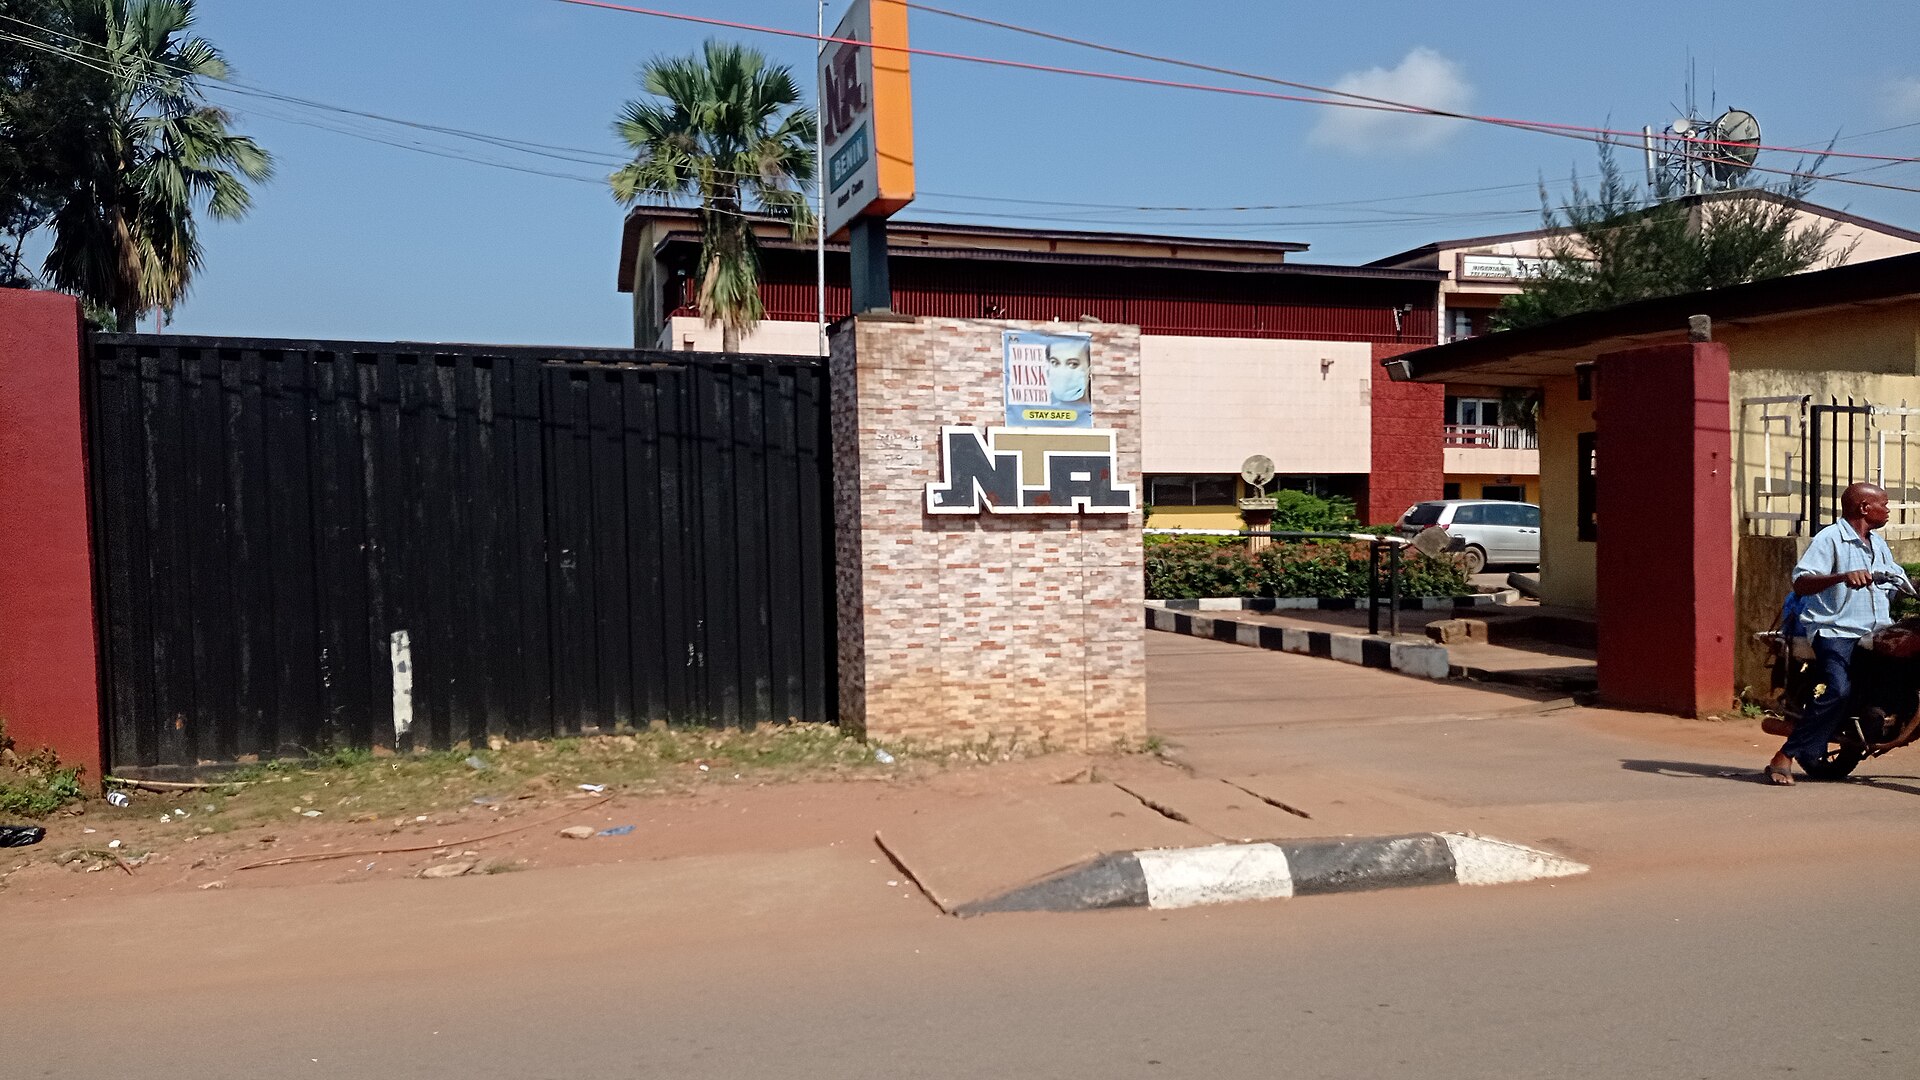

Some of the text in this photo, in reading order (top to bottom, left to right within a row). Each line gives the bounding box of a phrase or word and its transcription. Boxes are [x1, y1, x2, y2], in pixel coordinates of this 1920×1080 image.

[834, 136, 863, 181] BENIN
[1012, 347, 1043, 362] NO FACE
[1012, 365, 1047, 386] MASK
[1011, 388, 1048, 403] NO ENTRY
[1029, 411, 1071, 420] STAY SAFE
[927, 426, 1135, 514] NTA
